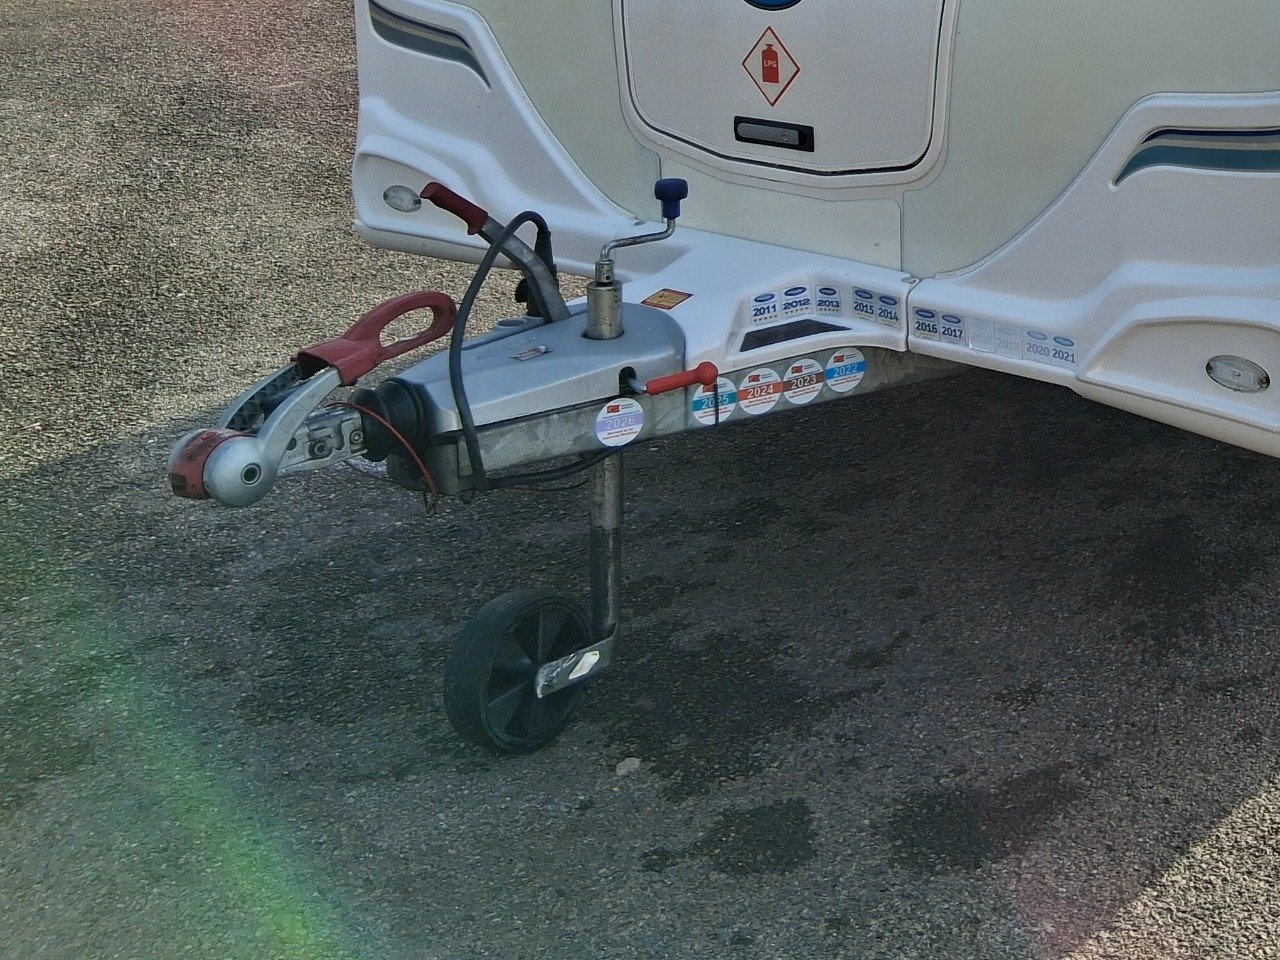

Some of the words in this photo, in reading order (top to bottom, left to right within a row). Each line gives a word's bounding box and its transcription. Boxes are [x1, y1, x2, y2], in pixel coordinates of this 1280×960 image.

[763, 59, 777, 68] LPG
[753, 304, 777, 317] 2011
[783, 298, 811, 310] 2012
[817, 299, 840, 308] 2013
[854, 301, 874, 315] 2015
[878, 307, 899, 322] 2014
[915, 321, 938, 334] 2016
[942, 326, 963, 339] 2017
[1026, 342, 1050, 357] 2020
[1052, 349, 1076, 363] 2021
[833, 363, 858, 377] 2022
[791, 374, 817, 389] 2023
[747, 384, 774, 398] 2024
[606, 415, 635, 430] 2026
